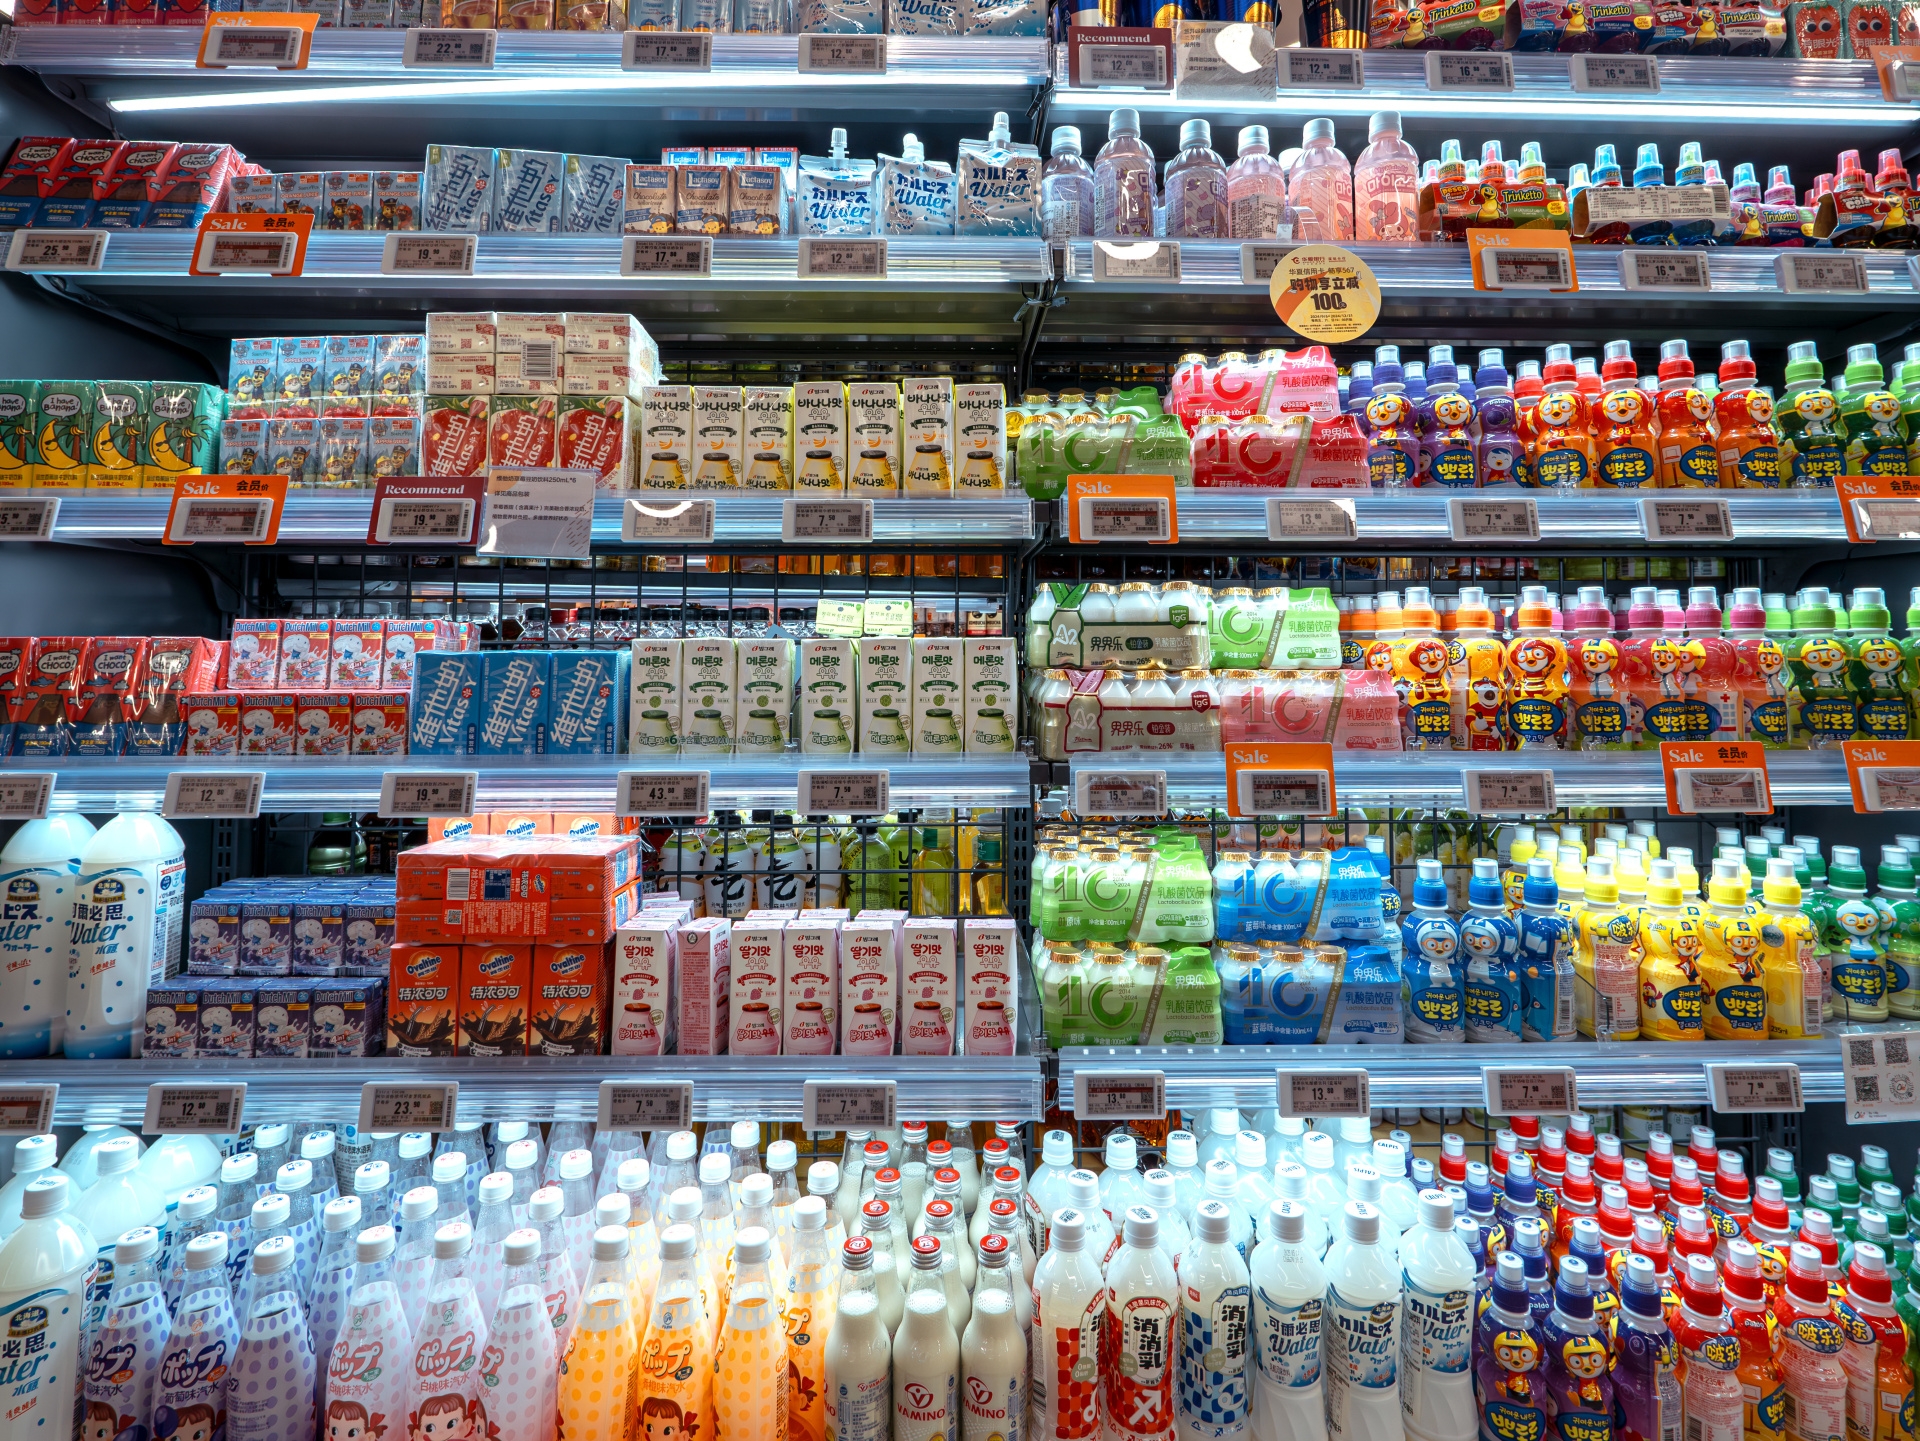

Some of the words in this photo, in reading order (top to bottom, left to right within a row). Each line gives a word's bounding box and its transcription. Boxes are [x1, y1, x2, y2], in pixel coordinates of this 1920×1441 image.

[1591, 5, 1631, 18] Trinketto
[1721, 11, 1761, 24] Trinketto
[1076, 33, 1150, 43] Recommend
[1803, 38, 1839, 49] 有眼光
[1854, 38, 1889, 49] 有眼光
[635, 172, 667, 188] Lactasoy
[687, 171, 719, 188] Lactasoy
[740, 172, 772, 188] Lactasoy
[897, 173, 948, 195] カルピス
[969, 181, 1031, 201] Water
[1502, 189, 1544, 202] Trinketto
[894, 189, 951, 211] Water
[263, 218, 295, 229] 会员价
[1763, 211, 1798, 223] Trinketto
[210, 218, 247, 230] Sale
[1290, 277, 1360, 290] 购物享立减
[798, 398, 842, 410] 바나나맛
[852, 398, 896, 410] 바나나맛
[907, 392, 951, 404] 바나나맛
[958, 398, 1002, 410] 바나나맛
[1605, 463, 1646, 478] 뽀로로
[182, 482, 220, 495] Sale
[237, 480, 269, 492] 会员价
[385, 484, 464, 495] Recommend
[1076, 482, 1112, 494] Sale
[1843, 482, 1877, 494] Sale
[1172, 613, 1187, 622] IgG
[1289, 621, 1332, 633] 乳酸菌饮品
[1091, 636, 1123, 651] 界界乐
[41, 661, 76, 670] CHOCO!
[94, 662, 131, 672] CHOCO!
[639, 656, 670, 667] 메론맛
[692, 656, 723, 667] 메론맛
[810, 656, 840, 667] 메론맛
[868, 656, 899, 667] 메론맛
[922, 655, 952, 666] 메론맛
[1195, 698, 1208, 707] IgG
[1347, 708, 1393, 720] 乳酸菌饮品
[1513, 711, 1553, 730] 뽀로로
[1152, 723, 1171, 733] 铂金装
[1581, 712, 1622, 731] 뽀로로
[1111, 721, 1144, 736] 界界乐
[1233, 750, 1269, 764] Sale
[1669, 750, 1704, 763] Sale
[1718, 748, 1748, 759] 会员价
[1852, 749, 1887, 761] Sale
[1158, 887, 1205, 899] 乳酸菌饮品
[1067, 917, 1081, 926] 原味
[1245, 921, 1266, 931] 蓝莓味
[71, 922, 126, 945] Water
[4, 944, 39, 952] ウォーター
[624, 945, 654, 959] 딸기맛
[739, 946, 771, 957] 딸기맛
[793, 944, 824, 958] 딸기맛
[851, 945, 882, 958] 딸기맛
[911, 943, 942, 957] 딸기맛
[406, 954, 442, 974] Ovaltine
[479, 954, 515, 973] Ovaltine
[550, 953, 585, 972] Ovaltine
[1353, 968, 1383, 982] 界界乐
[1175, 975, 1205, 989] 界界乐
[398, 987, 450, 1000] 特浓可可
[471, 985, 521, 999] 特浓可可
[542, 985, 593, 998] 特浓可可
[1345, 992, 1393, 1004] 乳酸菌饮品
[1166, 1000, 1214, 1013] 乳酸菌饮品
[1252, 1023, 1273, 1034] 蓝莓味
[1070, 1034, 1085, 1044] 原味
[14, 1311, 40, 1323] 北海道
[1411, 1299, 1466, 1324] カルピス
[1339, 1314, 1393, 1338] カルピス
[1797, 1323, 1844, 1347] 啵乐乐
[1133, 1316, 1162, 1370] 消消乳
[1269, 1335, 1320, 1357] Water
[416, 1336, 472, 1377] ポップ
[162, 1341, 226, 1386] ポップ
[330, 1382, 372, 1396] 白桃味汽水
[420, 1372, 470, 1393] 白桃味汽水
[165, 1382, 219, 1404] 葡萄味汽水
[897, 1403, 945, 1421] VAMINO
